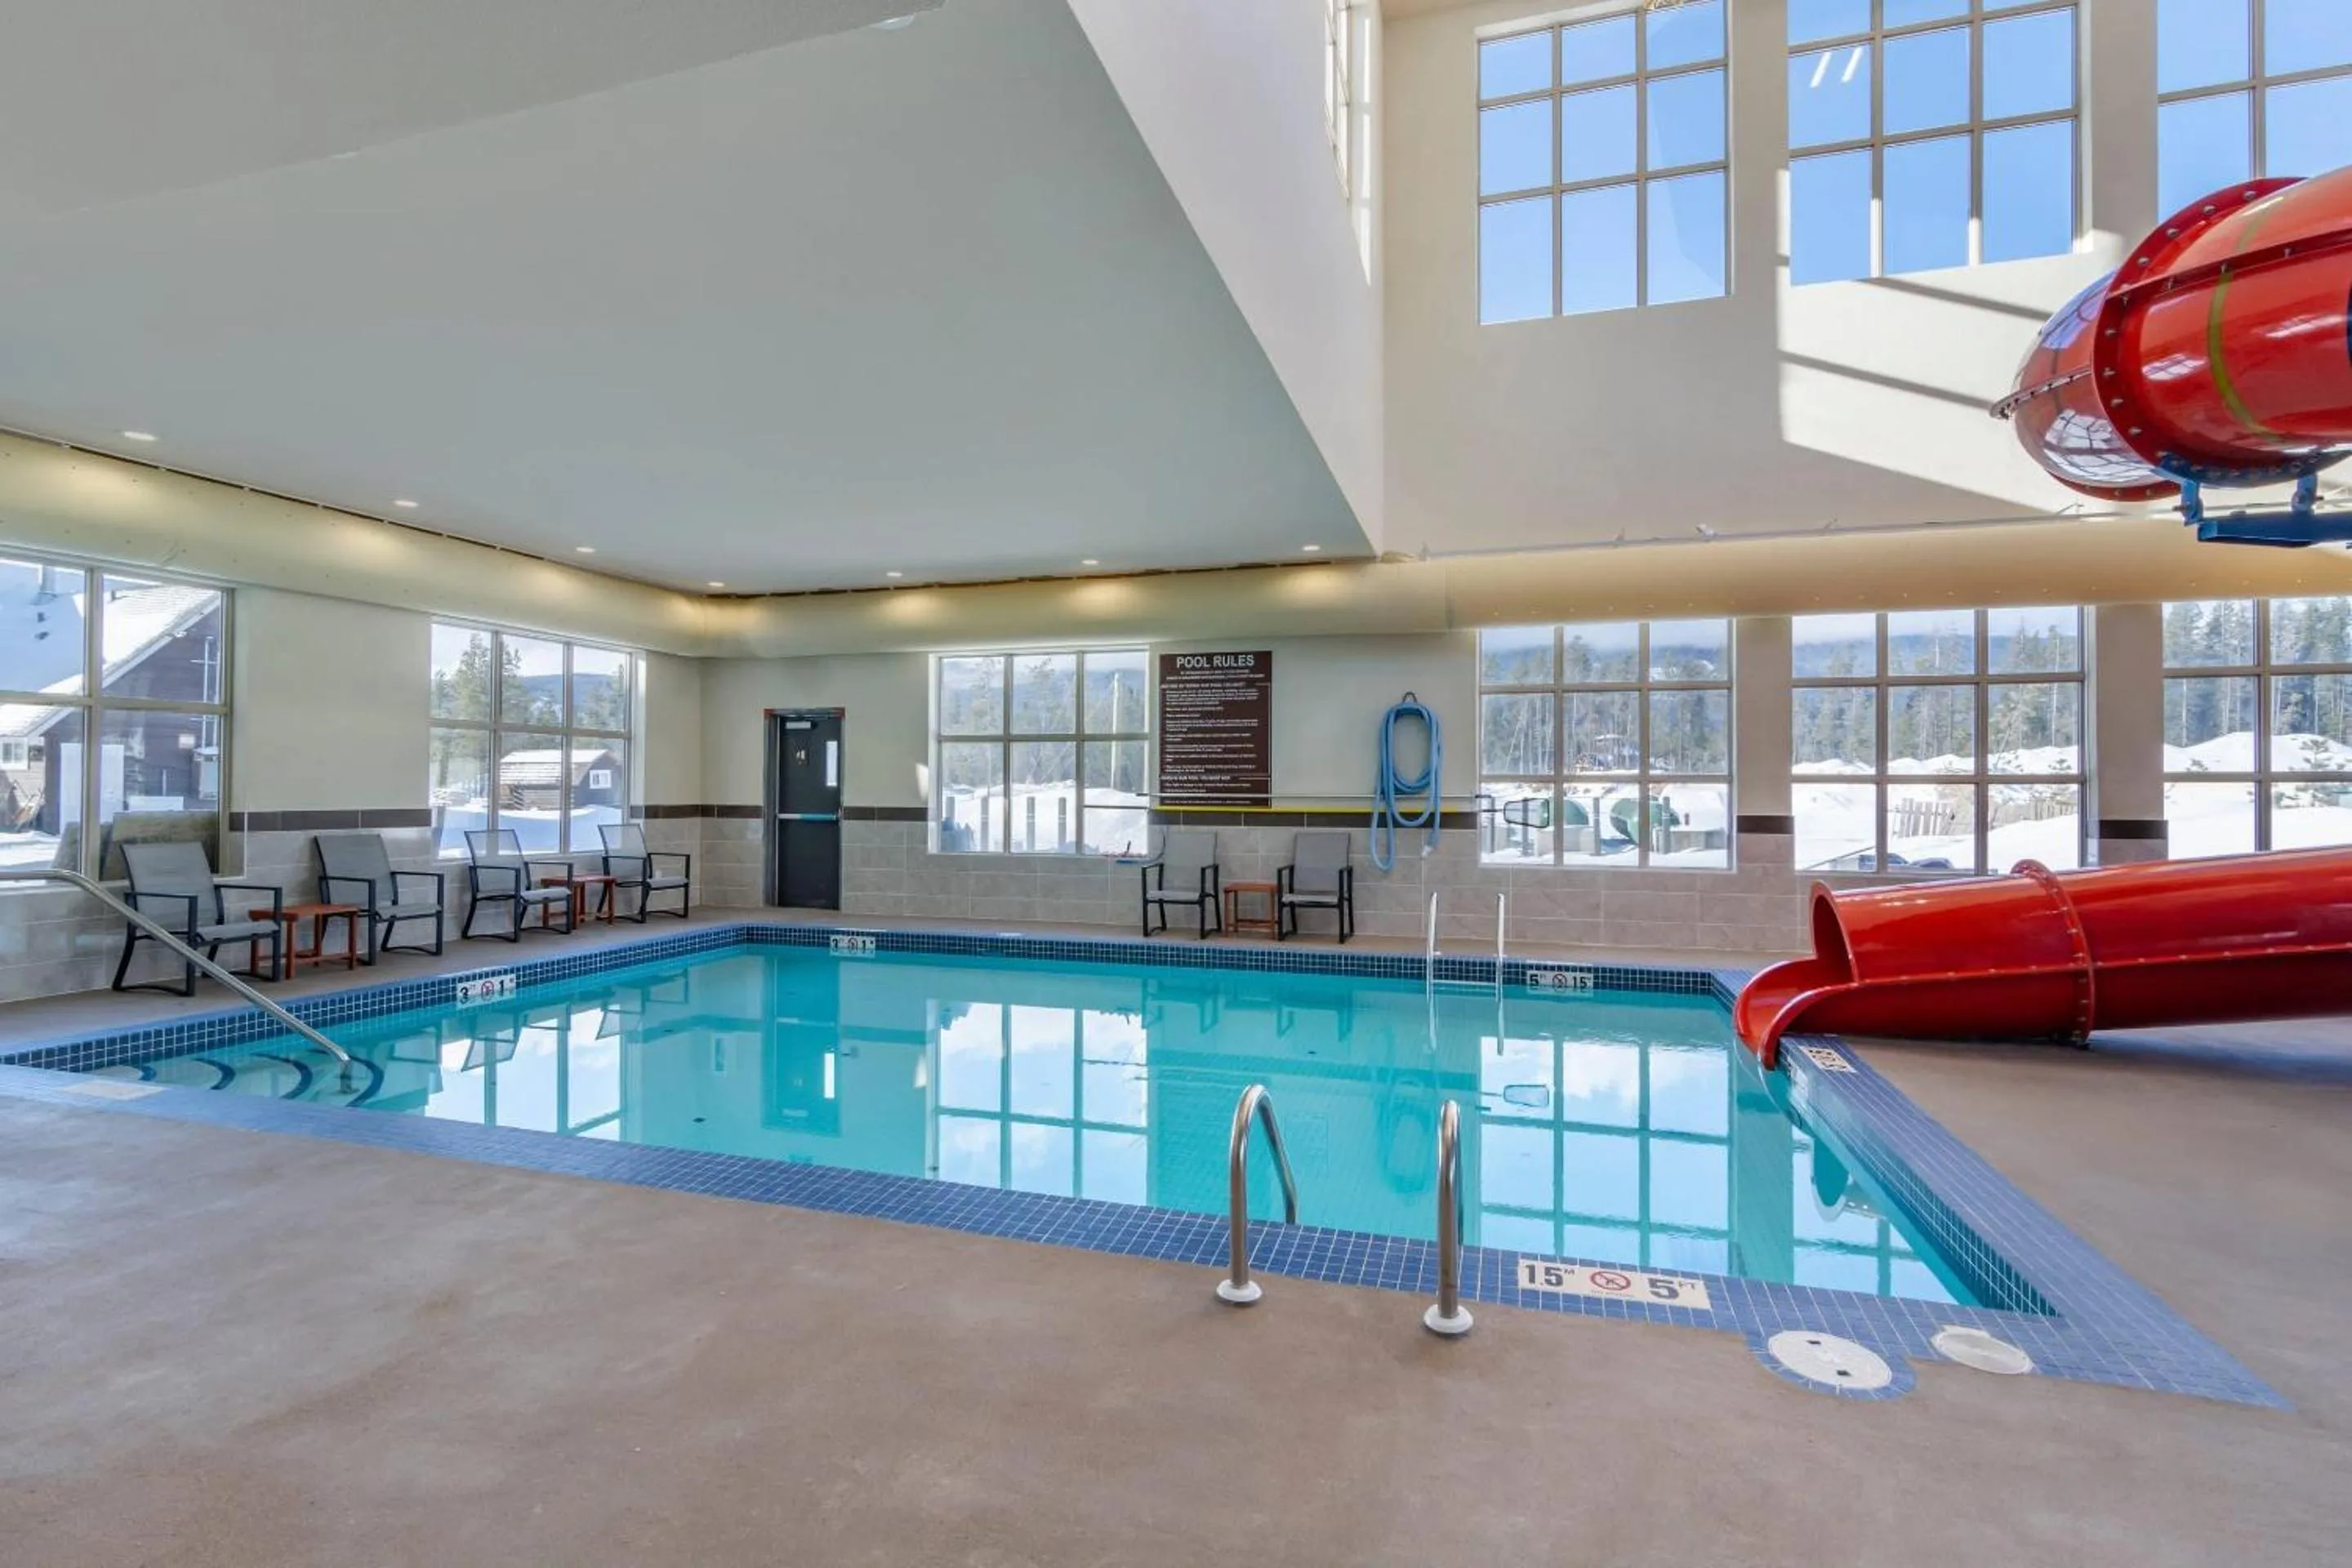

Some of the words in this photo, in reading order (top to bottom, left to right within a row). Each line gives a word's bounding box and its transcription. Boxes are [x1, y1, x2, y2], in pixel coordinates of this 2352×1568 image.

[1177, 656, 1210, 668] POOL
[1213, 654, 1255, 667] RULES
[1647, 1277, 1679, 1299] 5
